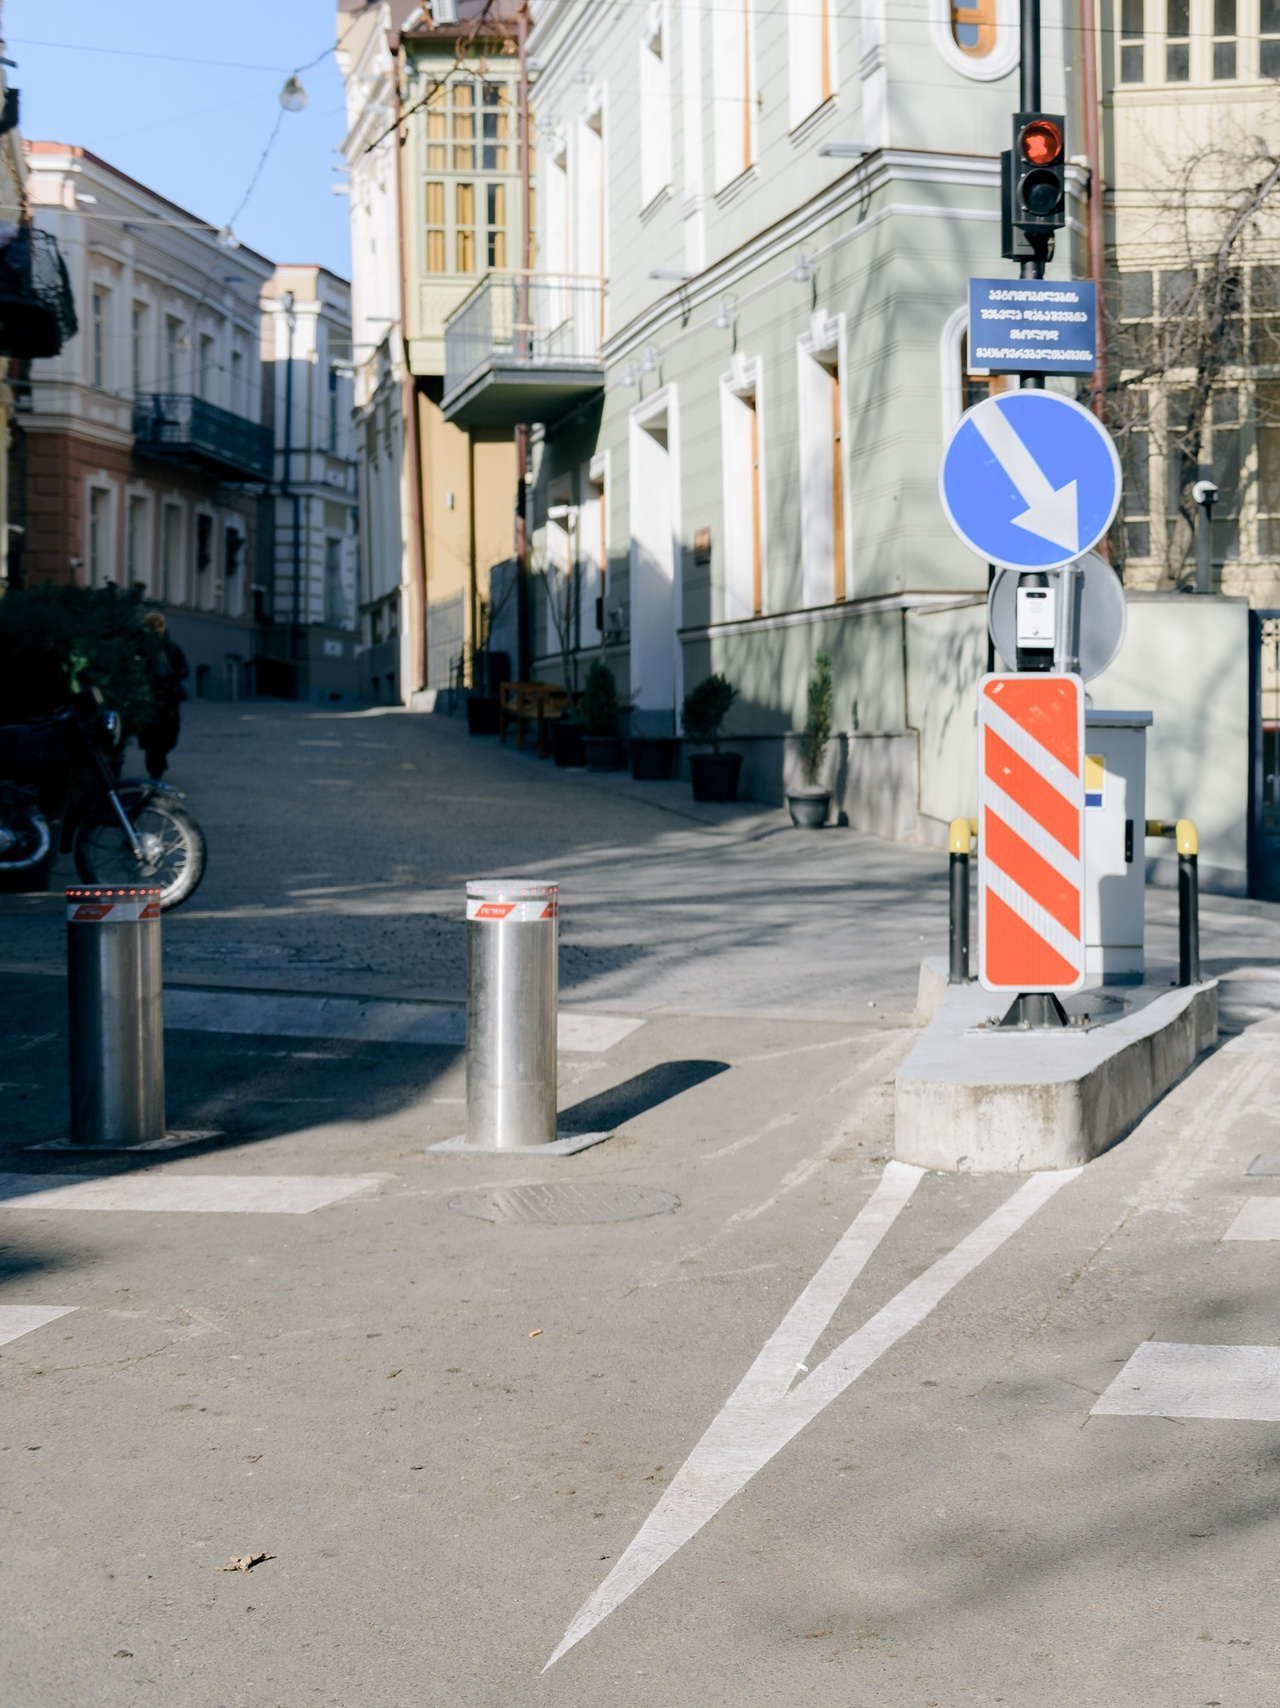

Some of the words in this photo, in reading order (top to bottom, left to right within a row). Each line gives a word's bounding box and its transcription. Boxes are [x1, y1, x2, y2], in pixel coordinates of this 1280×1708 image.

[989, 290, 1079, 302] ავტომობილების
[980, 309, 1022, 320] შესვლა
[1010, 329, 1059, 340] მხოლოდ
